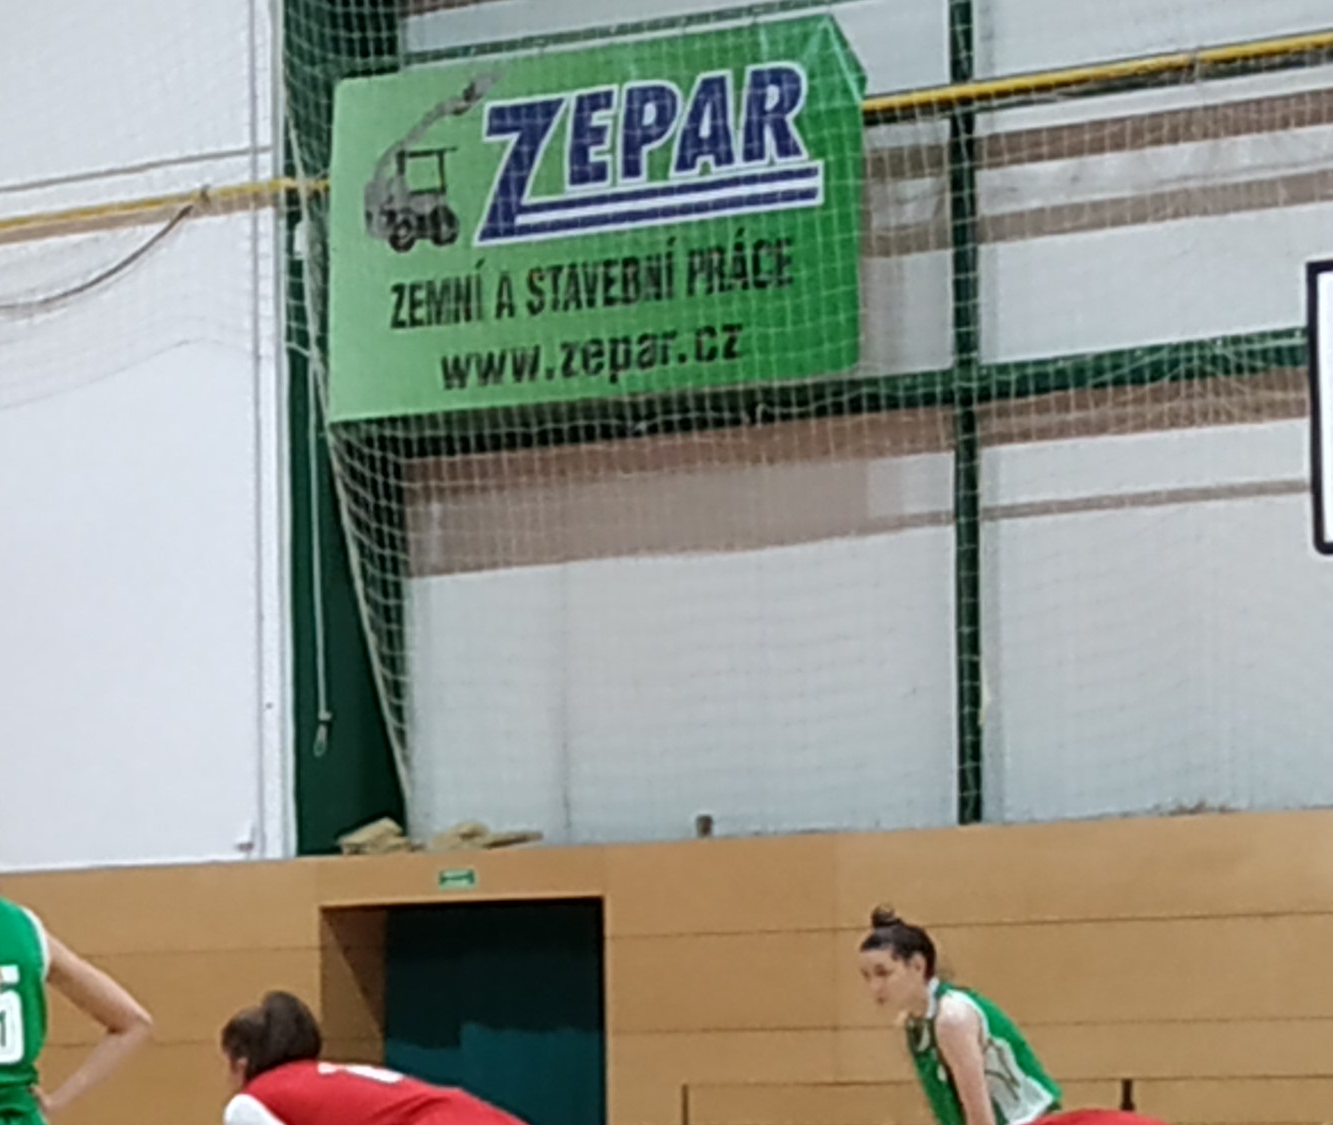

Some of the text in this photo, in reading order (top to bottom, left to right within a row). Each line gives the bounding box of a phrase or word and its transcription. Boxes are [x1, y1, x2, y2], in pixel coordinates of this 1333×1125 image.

[473, 60, 825, 247] ZEPAR
[390, 227, 794, 329] ZEMNÍ A STAVEBNÍ PRÁCE
[440, 323, 744, 391] www.zepar.cz
